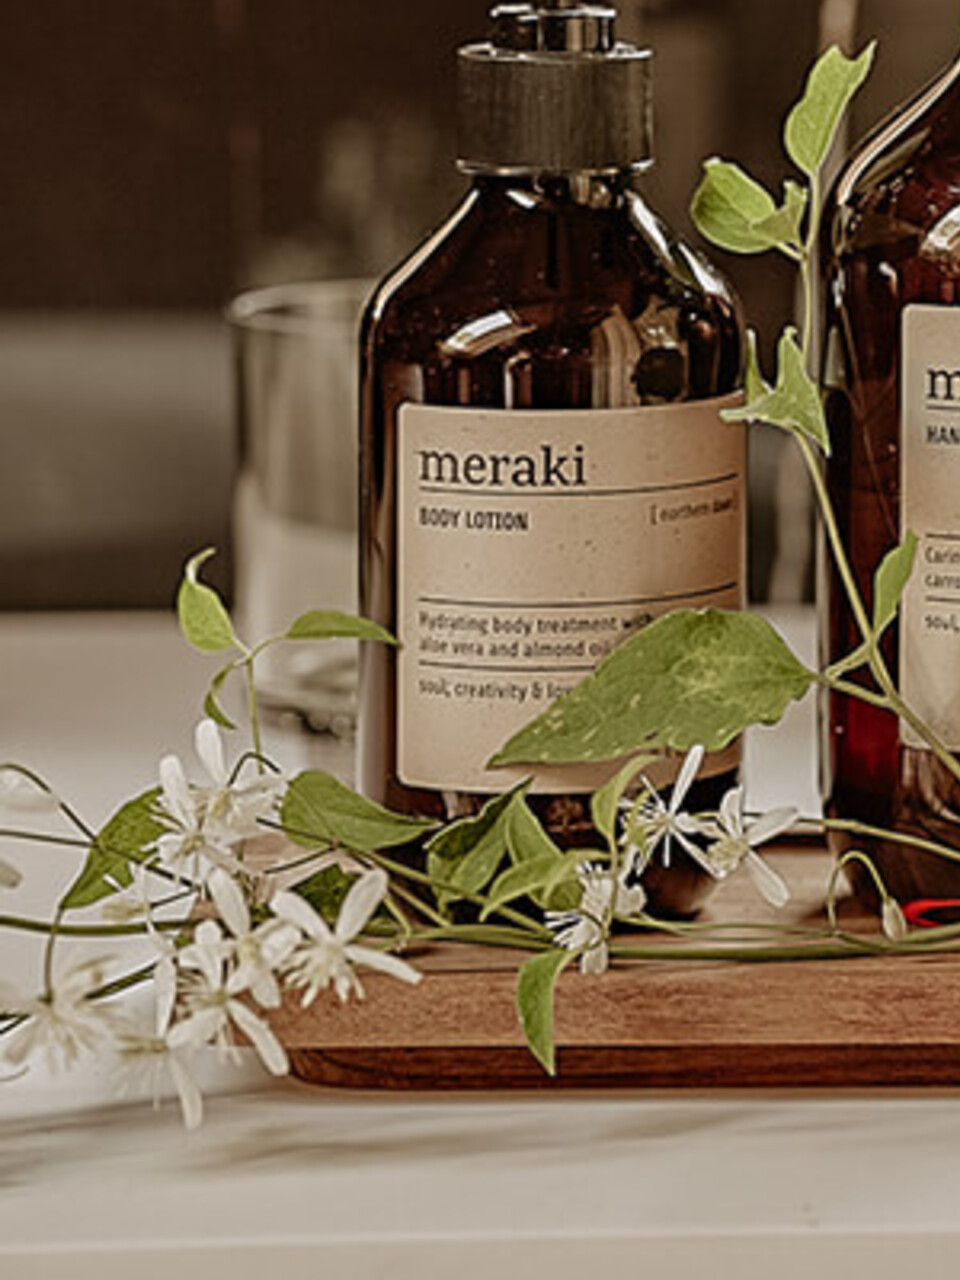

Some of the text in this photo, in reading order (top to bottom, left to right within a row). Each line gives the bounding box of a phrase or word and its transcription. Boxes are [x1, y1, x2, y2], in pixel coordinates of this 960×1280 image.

[418, 444, 587, 487] meraki
[419, 507, 529, 531] BODY LOTION
[419, 611, 488, 636] Hydrating
[493, 616, 533, 636] body
[537, 617, 618, 633] treatment
[925, 614, 960, 633] soul,
[420, 637, 448, 654] aloe
[452, 642, 484, 656] vera
[489, 641, 519, 657] and
[523, 641, 585, 657] almond
[419, 679, 451, 698] soul,
[454, 683, 528, 704] creativity
[531, 682, 542, 699] &
